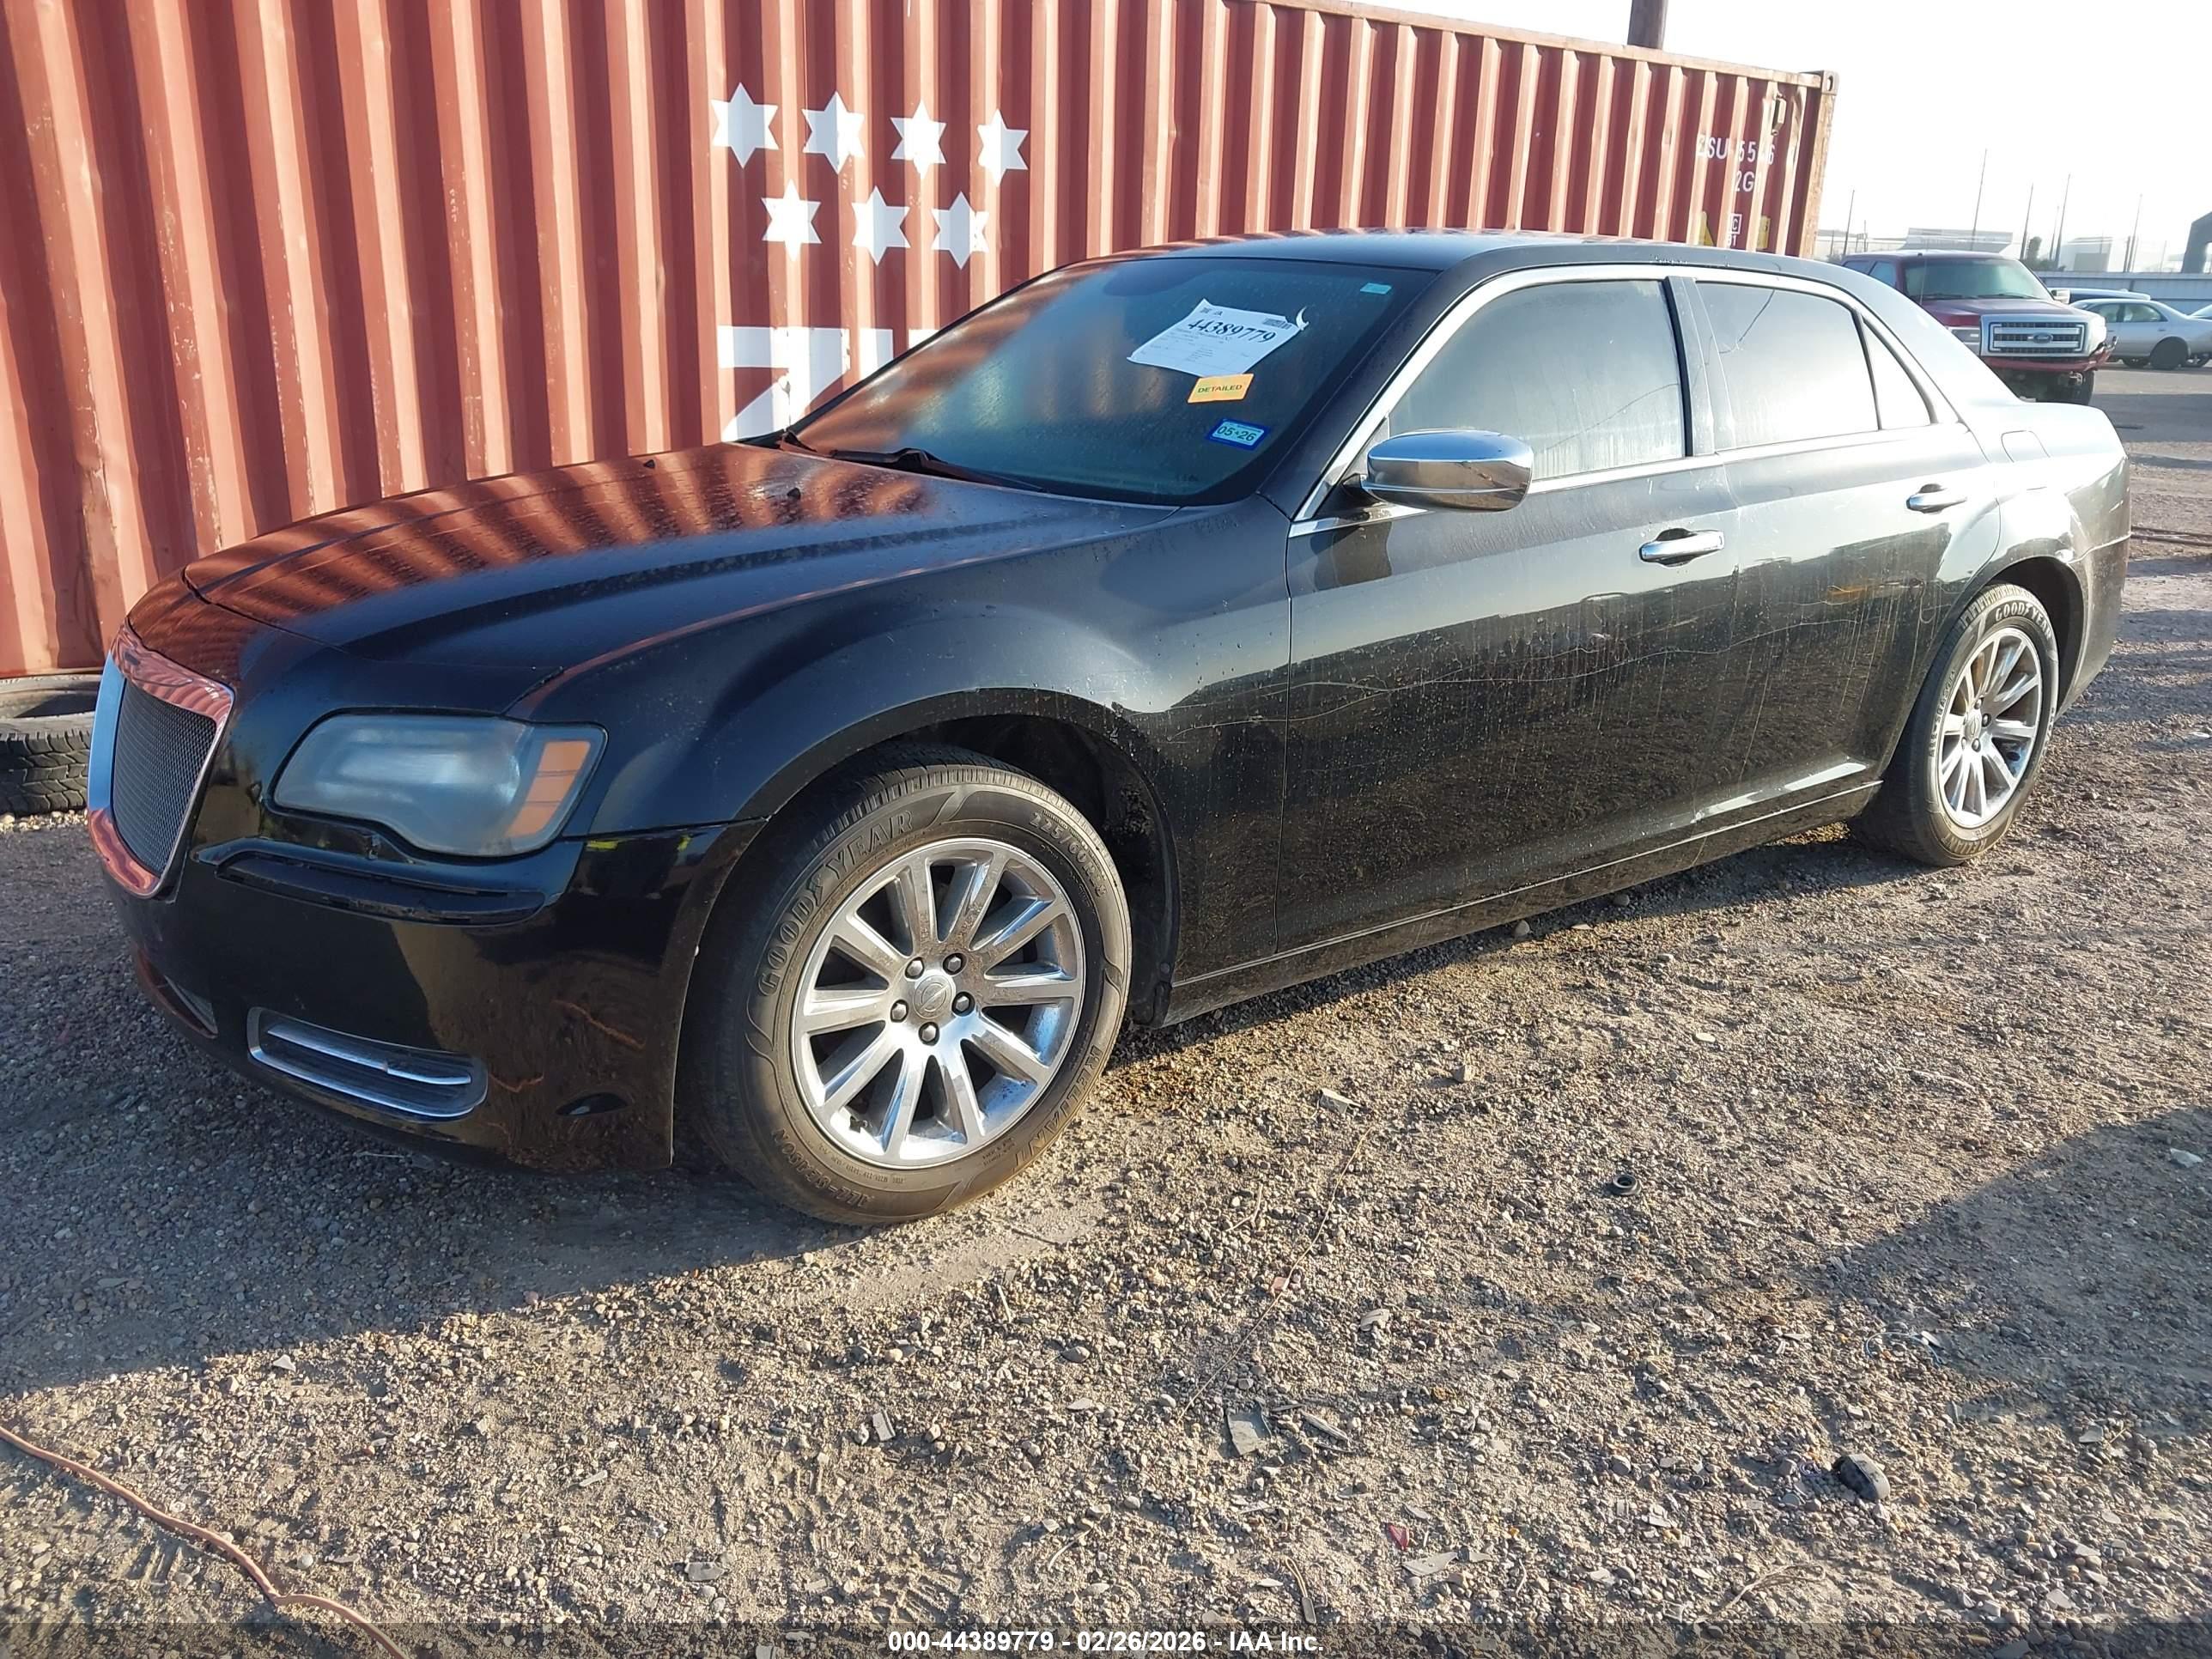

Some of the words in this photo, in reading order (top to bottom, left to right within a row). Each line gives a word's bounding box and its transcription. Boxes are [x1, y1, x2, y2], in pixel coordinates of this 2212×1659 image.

[1188, 319, 1276, 343] 44389779
[1198, 384, 1243, 393] DETAILED
[1995, 602, 2052, 640] GOODYEAR
[757, 810, 914, 996] GOODYEAR
[773, 1127, 874, 1207] ALL-SEASON
